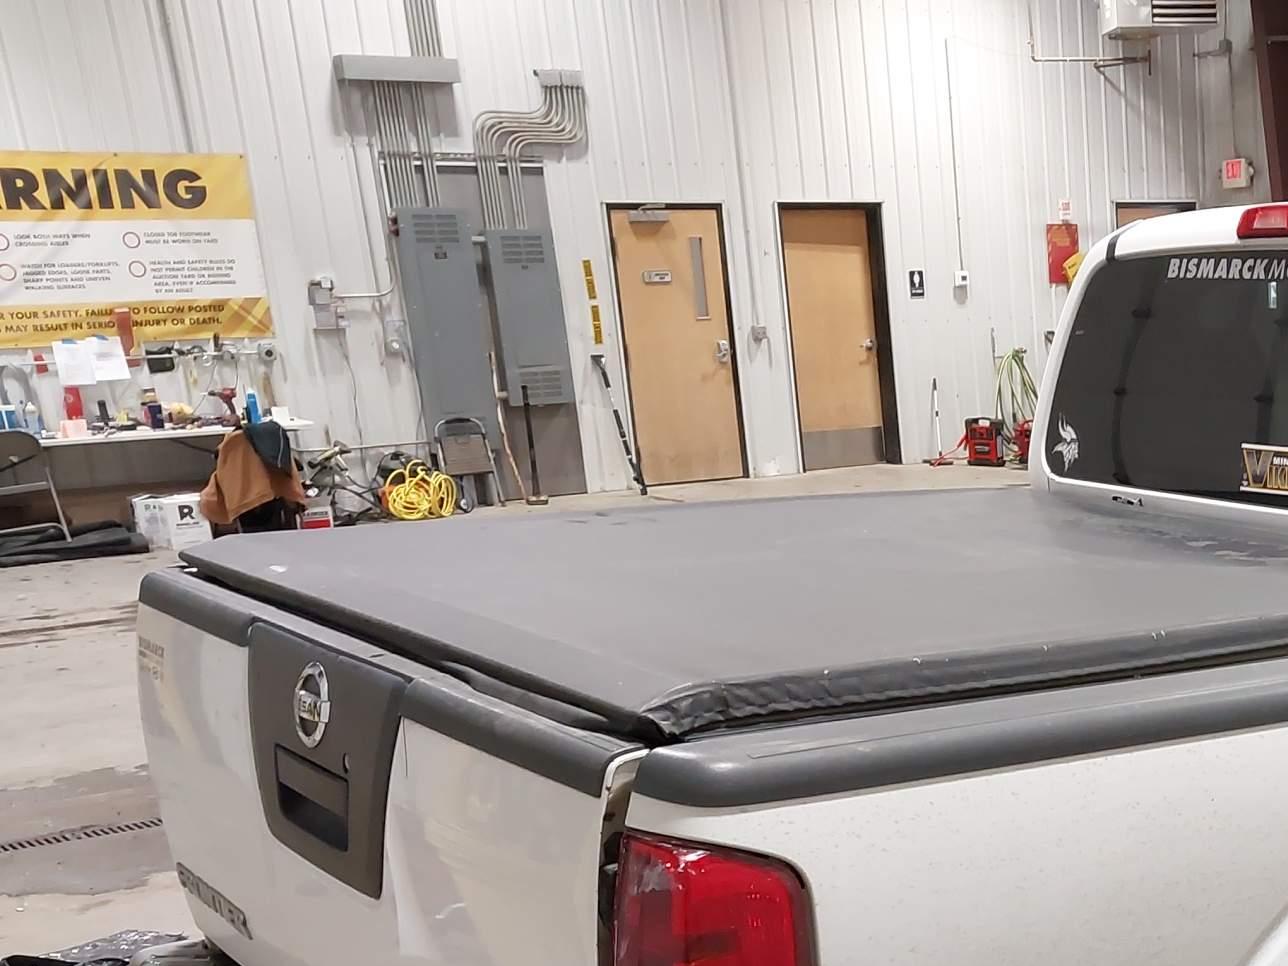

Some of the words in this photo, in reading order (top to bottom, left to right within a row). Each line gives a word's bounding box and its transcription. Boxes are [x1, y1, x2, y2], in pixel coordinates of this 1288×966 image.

[0, 168, 207, 210] RNING
[9, 311, 39, 320] YOUR
[85, 308, 114, 317] FAILU
[143, 305, 185, 314] FOLLOW
[187, 304, 225, 313] POSTED
[5, 324, 29, 333] MAY
[32, 322, 69, 332] RESULT
[71, 321, 83, 330] IN
[86, 320, 116, 330] SERIO
[132, 318, 167, 327] INJURY
[171, 317, 185, 326] OR
